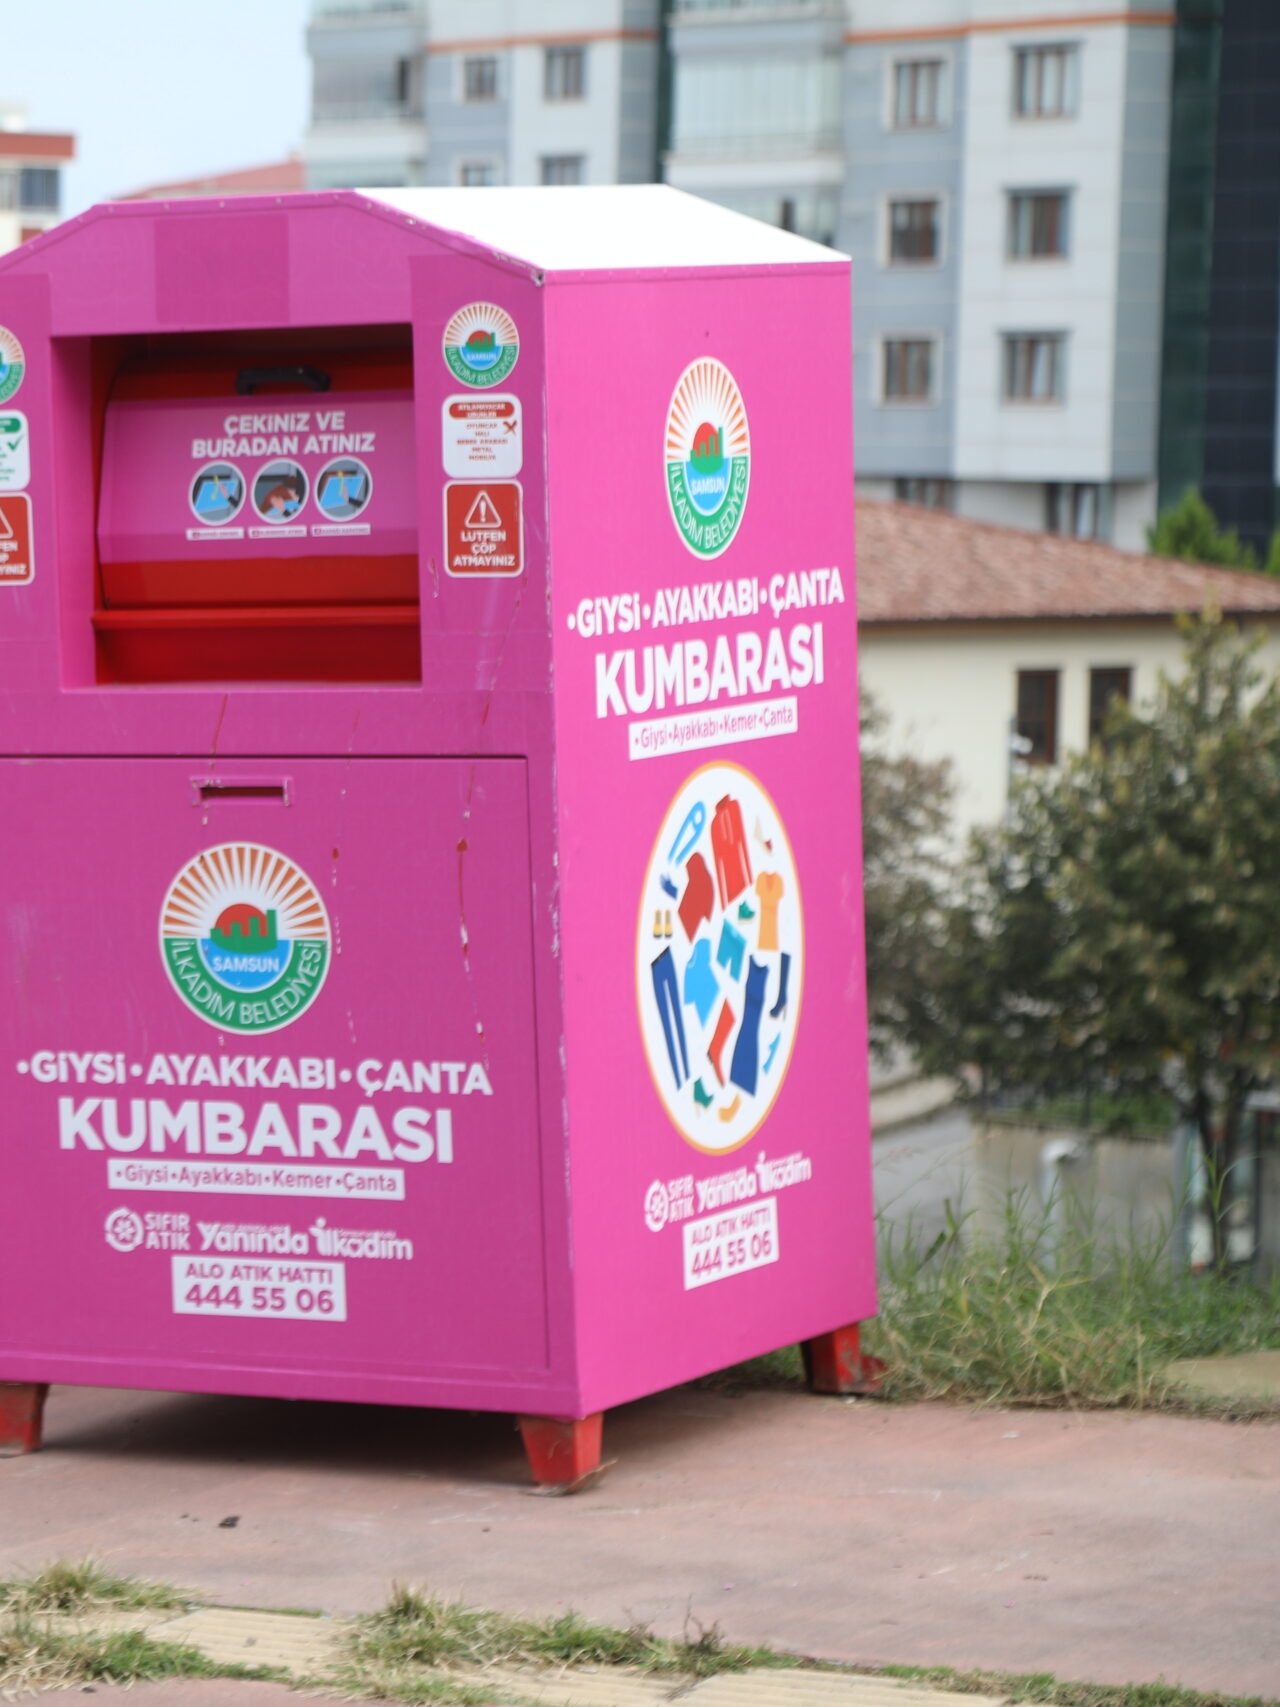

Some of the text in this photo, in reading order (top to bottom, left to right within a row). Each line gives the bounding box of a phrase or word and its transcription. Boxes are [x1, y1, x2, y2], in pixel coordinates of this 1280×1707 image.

[316, 411, 346, 431] VE
[191, 432, 376, 459] BURADAN ATINIZ
[691, 477, 725, 496] SAMSUN
[671, 464, 703, 547] İLKADIM
[453, 554, 516, 567] ATMAYINIZ
[651, 577, 759, 629] AYAKKABI
[769, 566, 846, 619] ÇANTA
[595, 621, 825, 720] KUMBARASI
[723, 711, 757, 733] Kemer
[213, 957, 280, 973] SAMSUN
[171, 941, 323, 1025] İLKADIM BELEDİYESİ
[145, 1053, 337, 1090] AYAKKABI
[356, 1058, 494, 1098] ÇANTA
[58, 1096, 454, 1165] KUMBARASI
[124, 1164, 397, 1193] Giysi Ayakkabı Kemer Çanta
[144, 1213, 191, 1232] SIFIR
[145, 1232, 192, 1251] ATIK
[196, 1221, 310, 1256] Yanında
[691, 1230, 772, 1279] 444 55 06
[185, 1262, 333, 1285] ALO ATIK HATTI
[185, 1283, 335, 1315] 444 55 06
